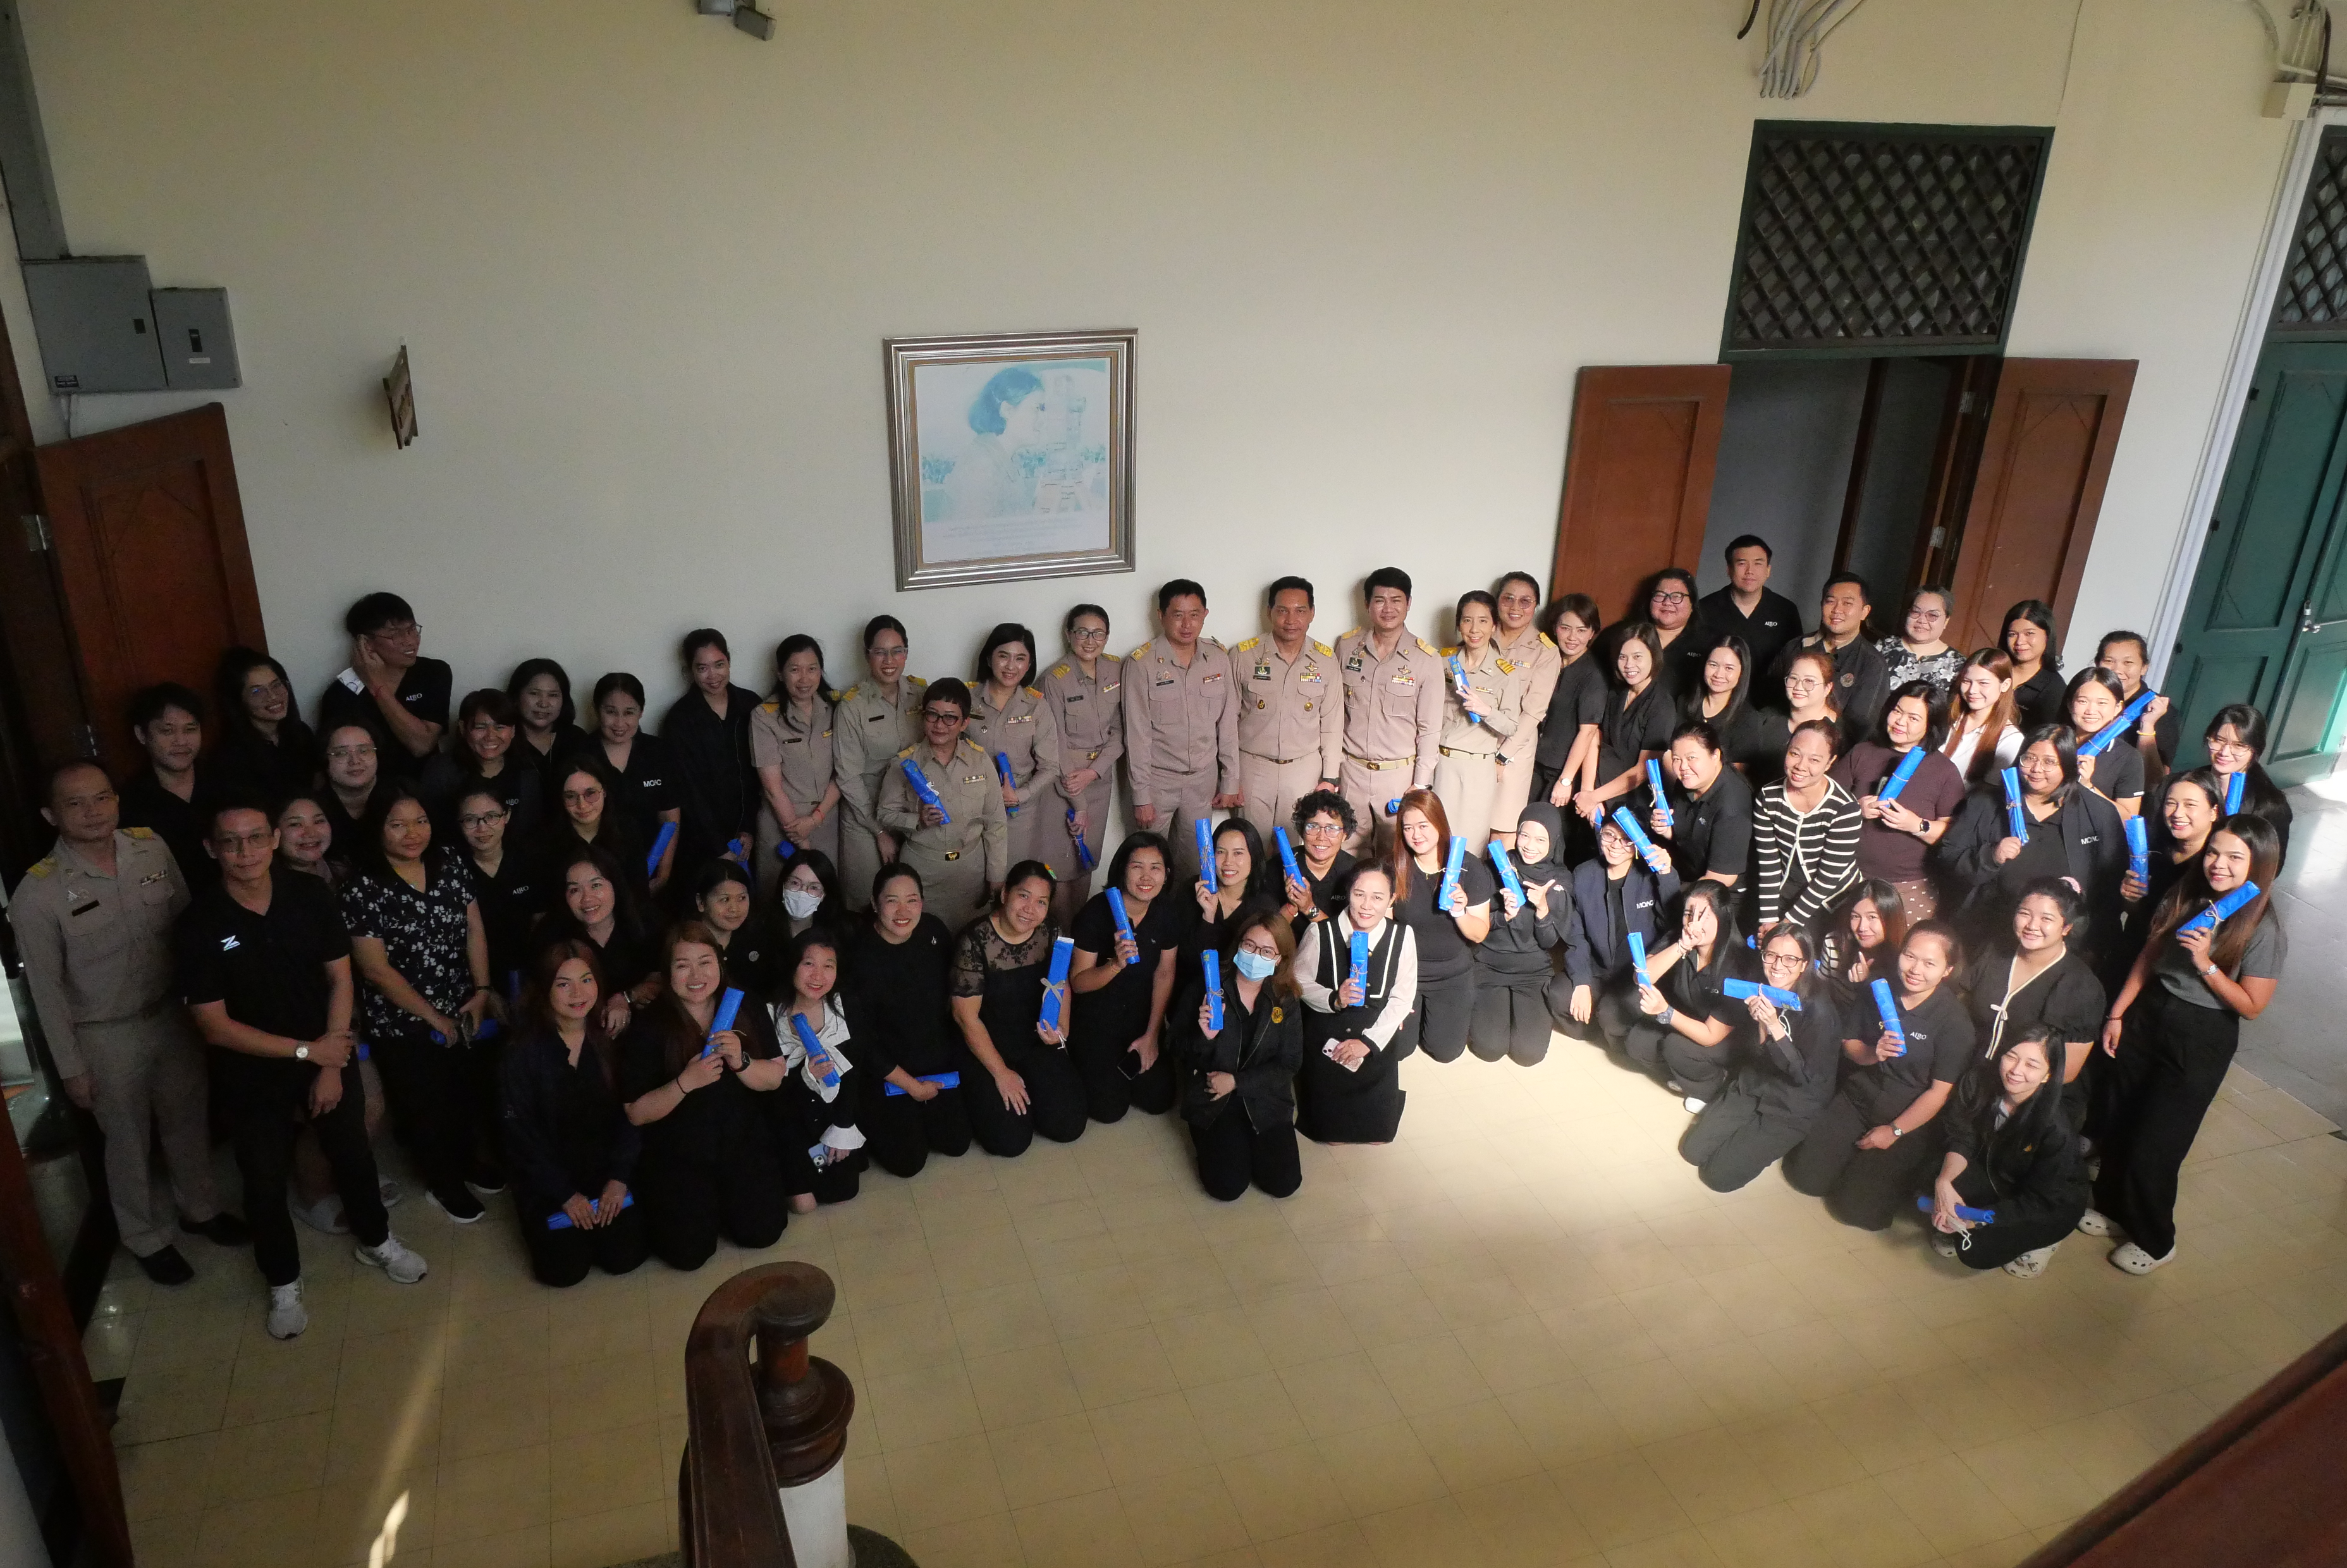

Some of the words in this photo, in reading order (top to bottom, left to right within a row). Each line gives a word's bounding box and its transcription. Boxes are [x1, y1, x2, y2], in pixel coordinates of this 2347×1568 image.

[642, 779, 662, 787] MOAC
[2080, 835, 2100, 845] MOAC
[1636, 900, 1654, 909] MOAC
[1909, 1031, 1927, 1040] ALRO
